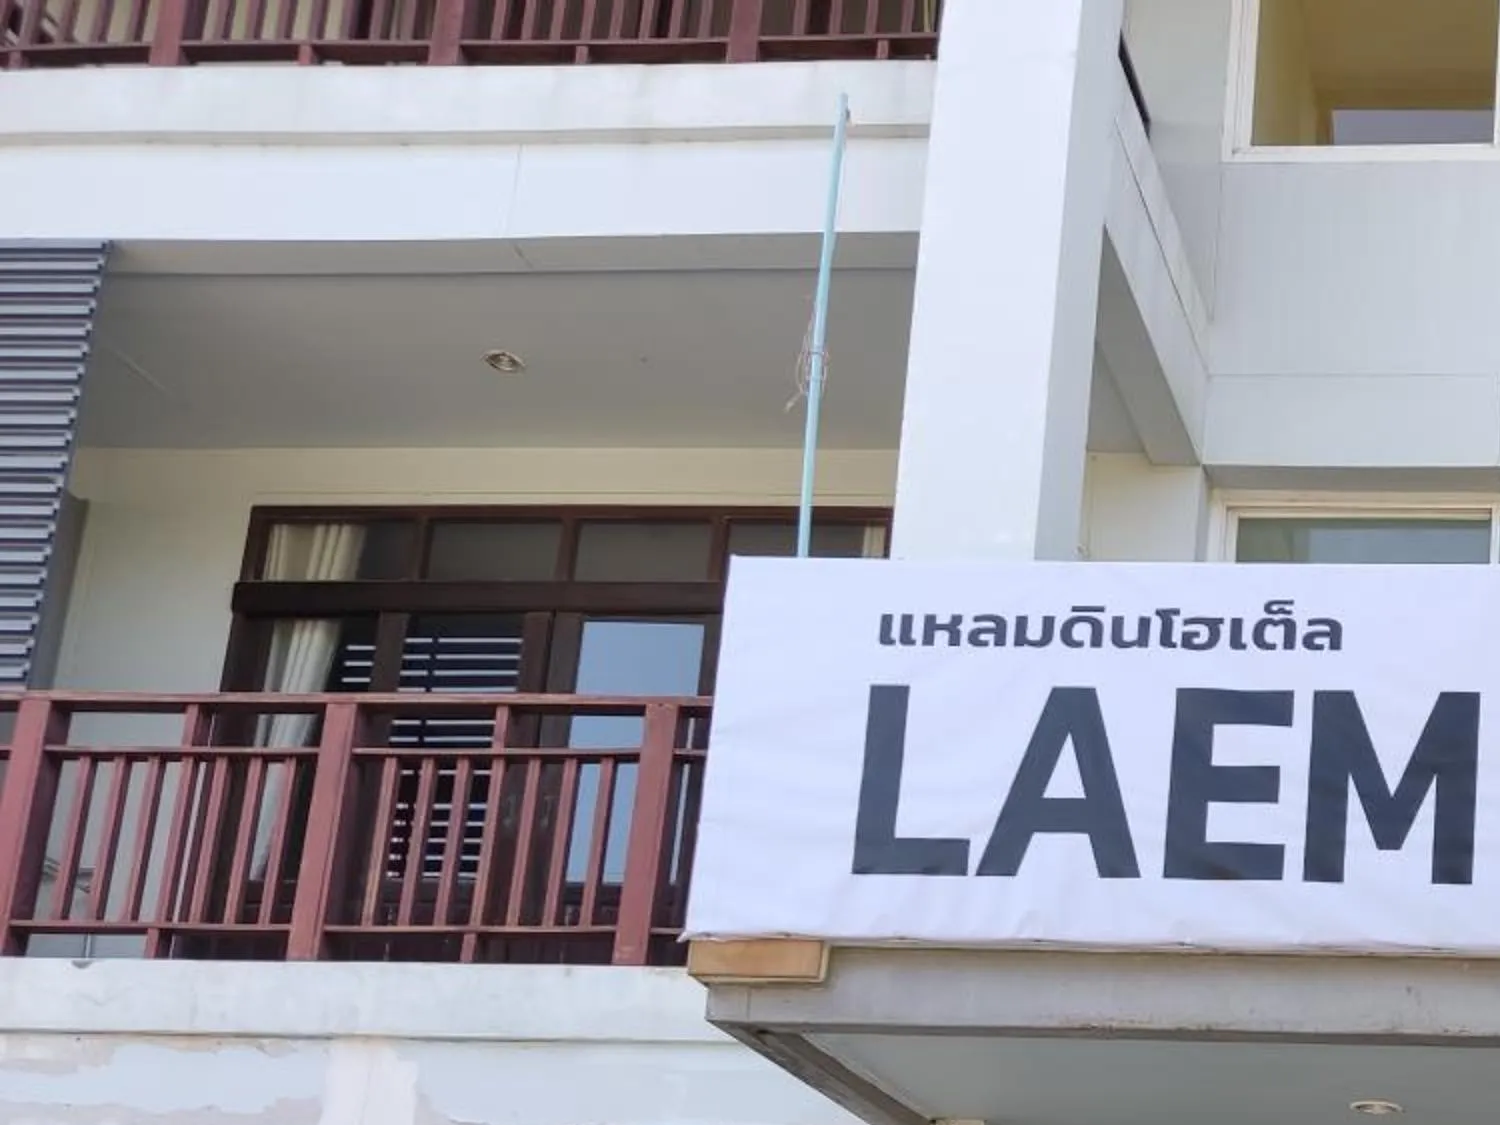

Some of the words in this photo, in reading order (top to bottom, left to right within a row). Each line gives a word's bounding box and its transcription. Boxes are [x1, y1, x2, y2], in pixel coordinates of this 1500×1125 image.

[878, 600, 1343, 651] แหลมดินโฮเต็ล
[851, 685, 1481, 885] LAEM
